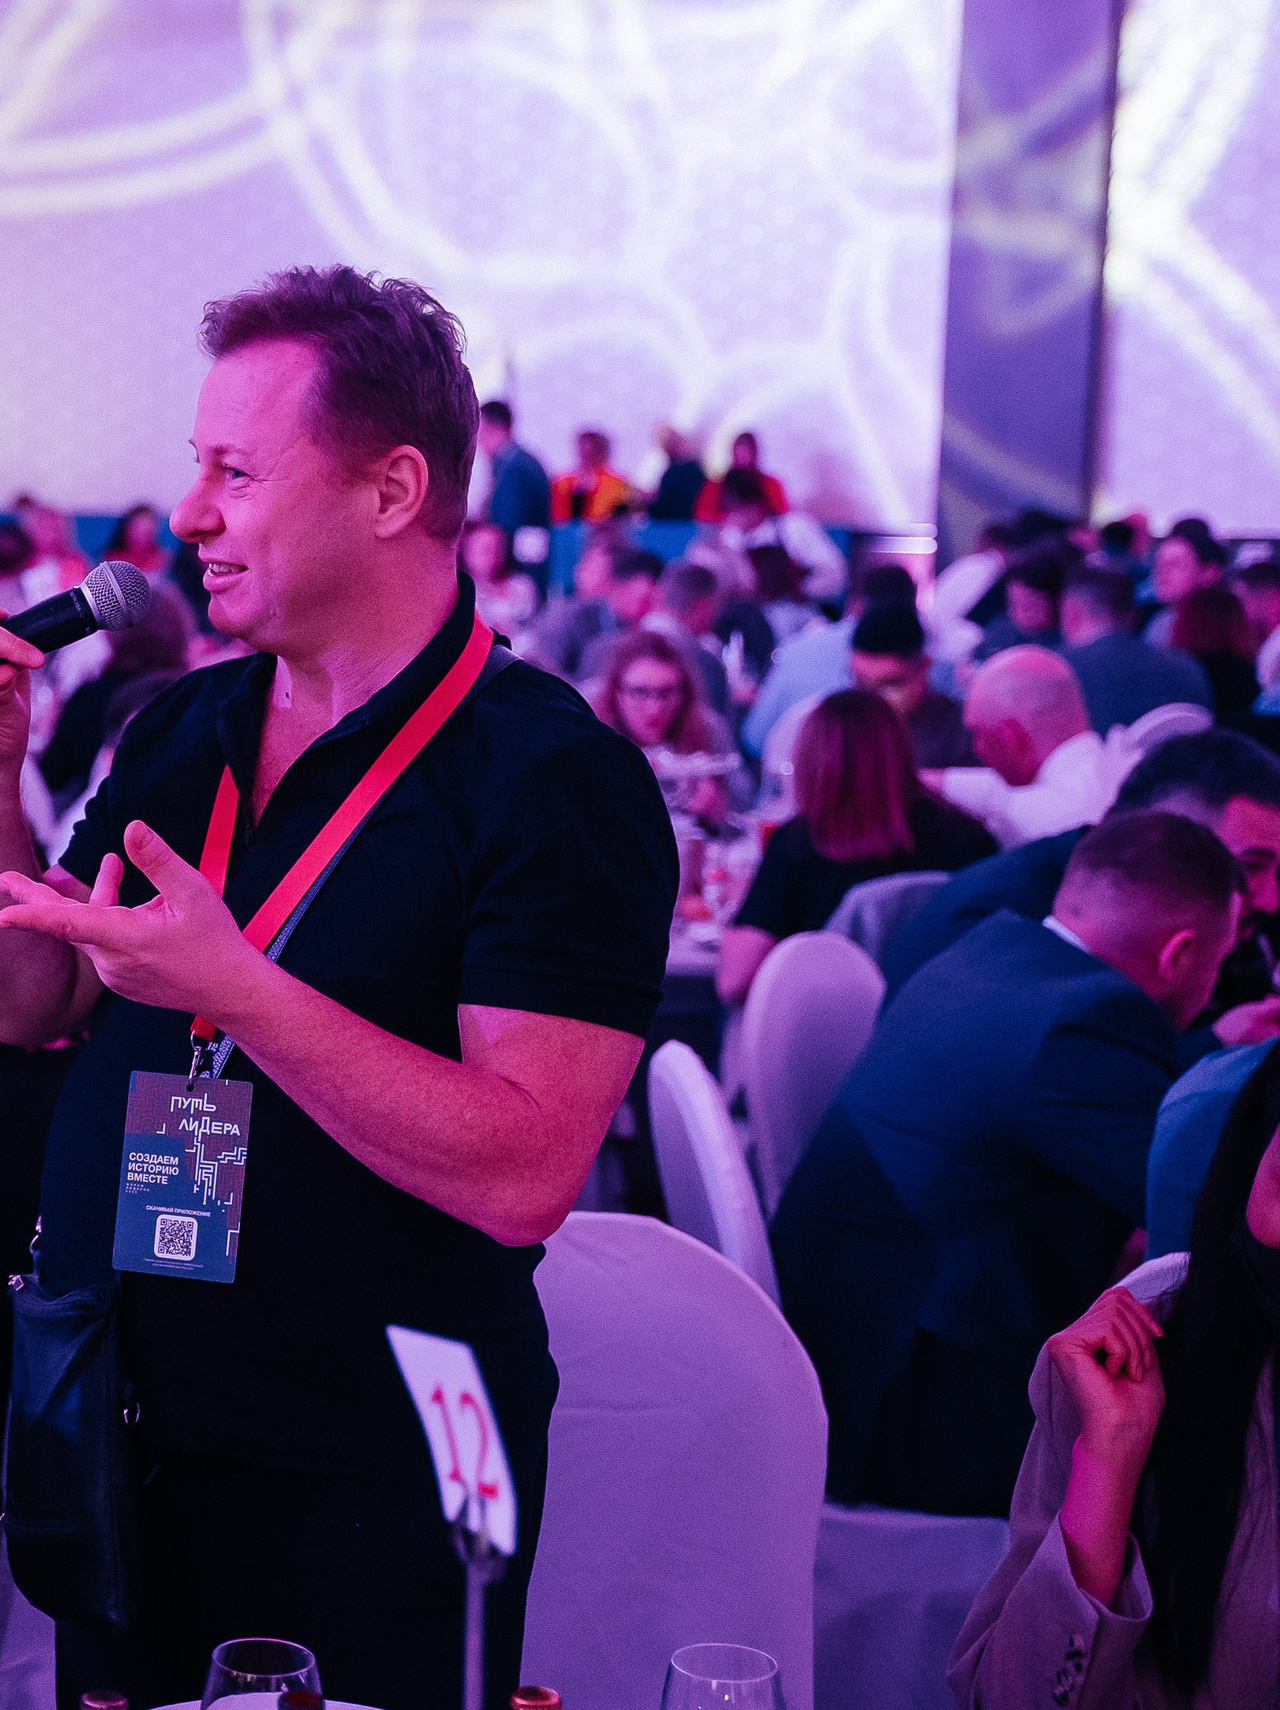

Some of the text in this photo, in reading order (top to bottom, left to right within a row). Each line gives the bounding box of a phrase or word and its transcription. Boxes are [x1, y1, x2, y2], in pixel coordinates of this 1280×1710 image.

[178, 1117, 241, 1138] ЛИДЕРА
[129, 1152, 179, 1165] СОЗДАЕМ
[128, 1162, 179, 1175] ИСТОРИЮ
[127, 1172, 168, 1184] ВМЕСТЕ
[431, 1386, 499, 1500] 12
